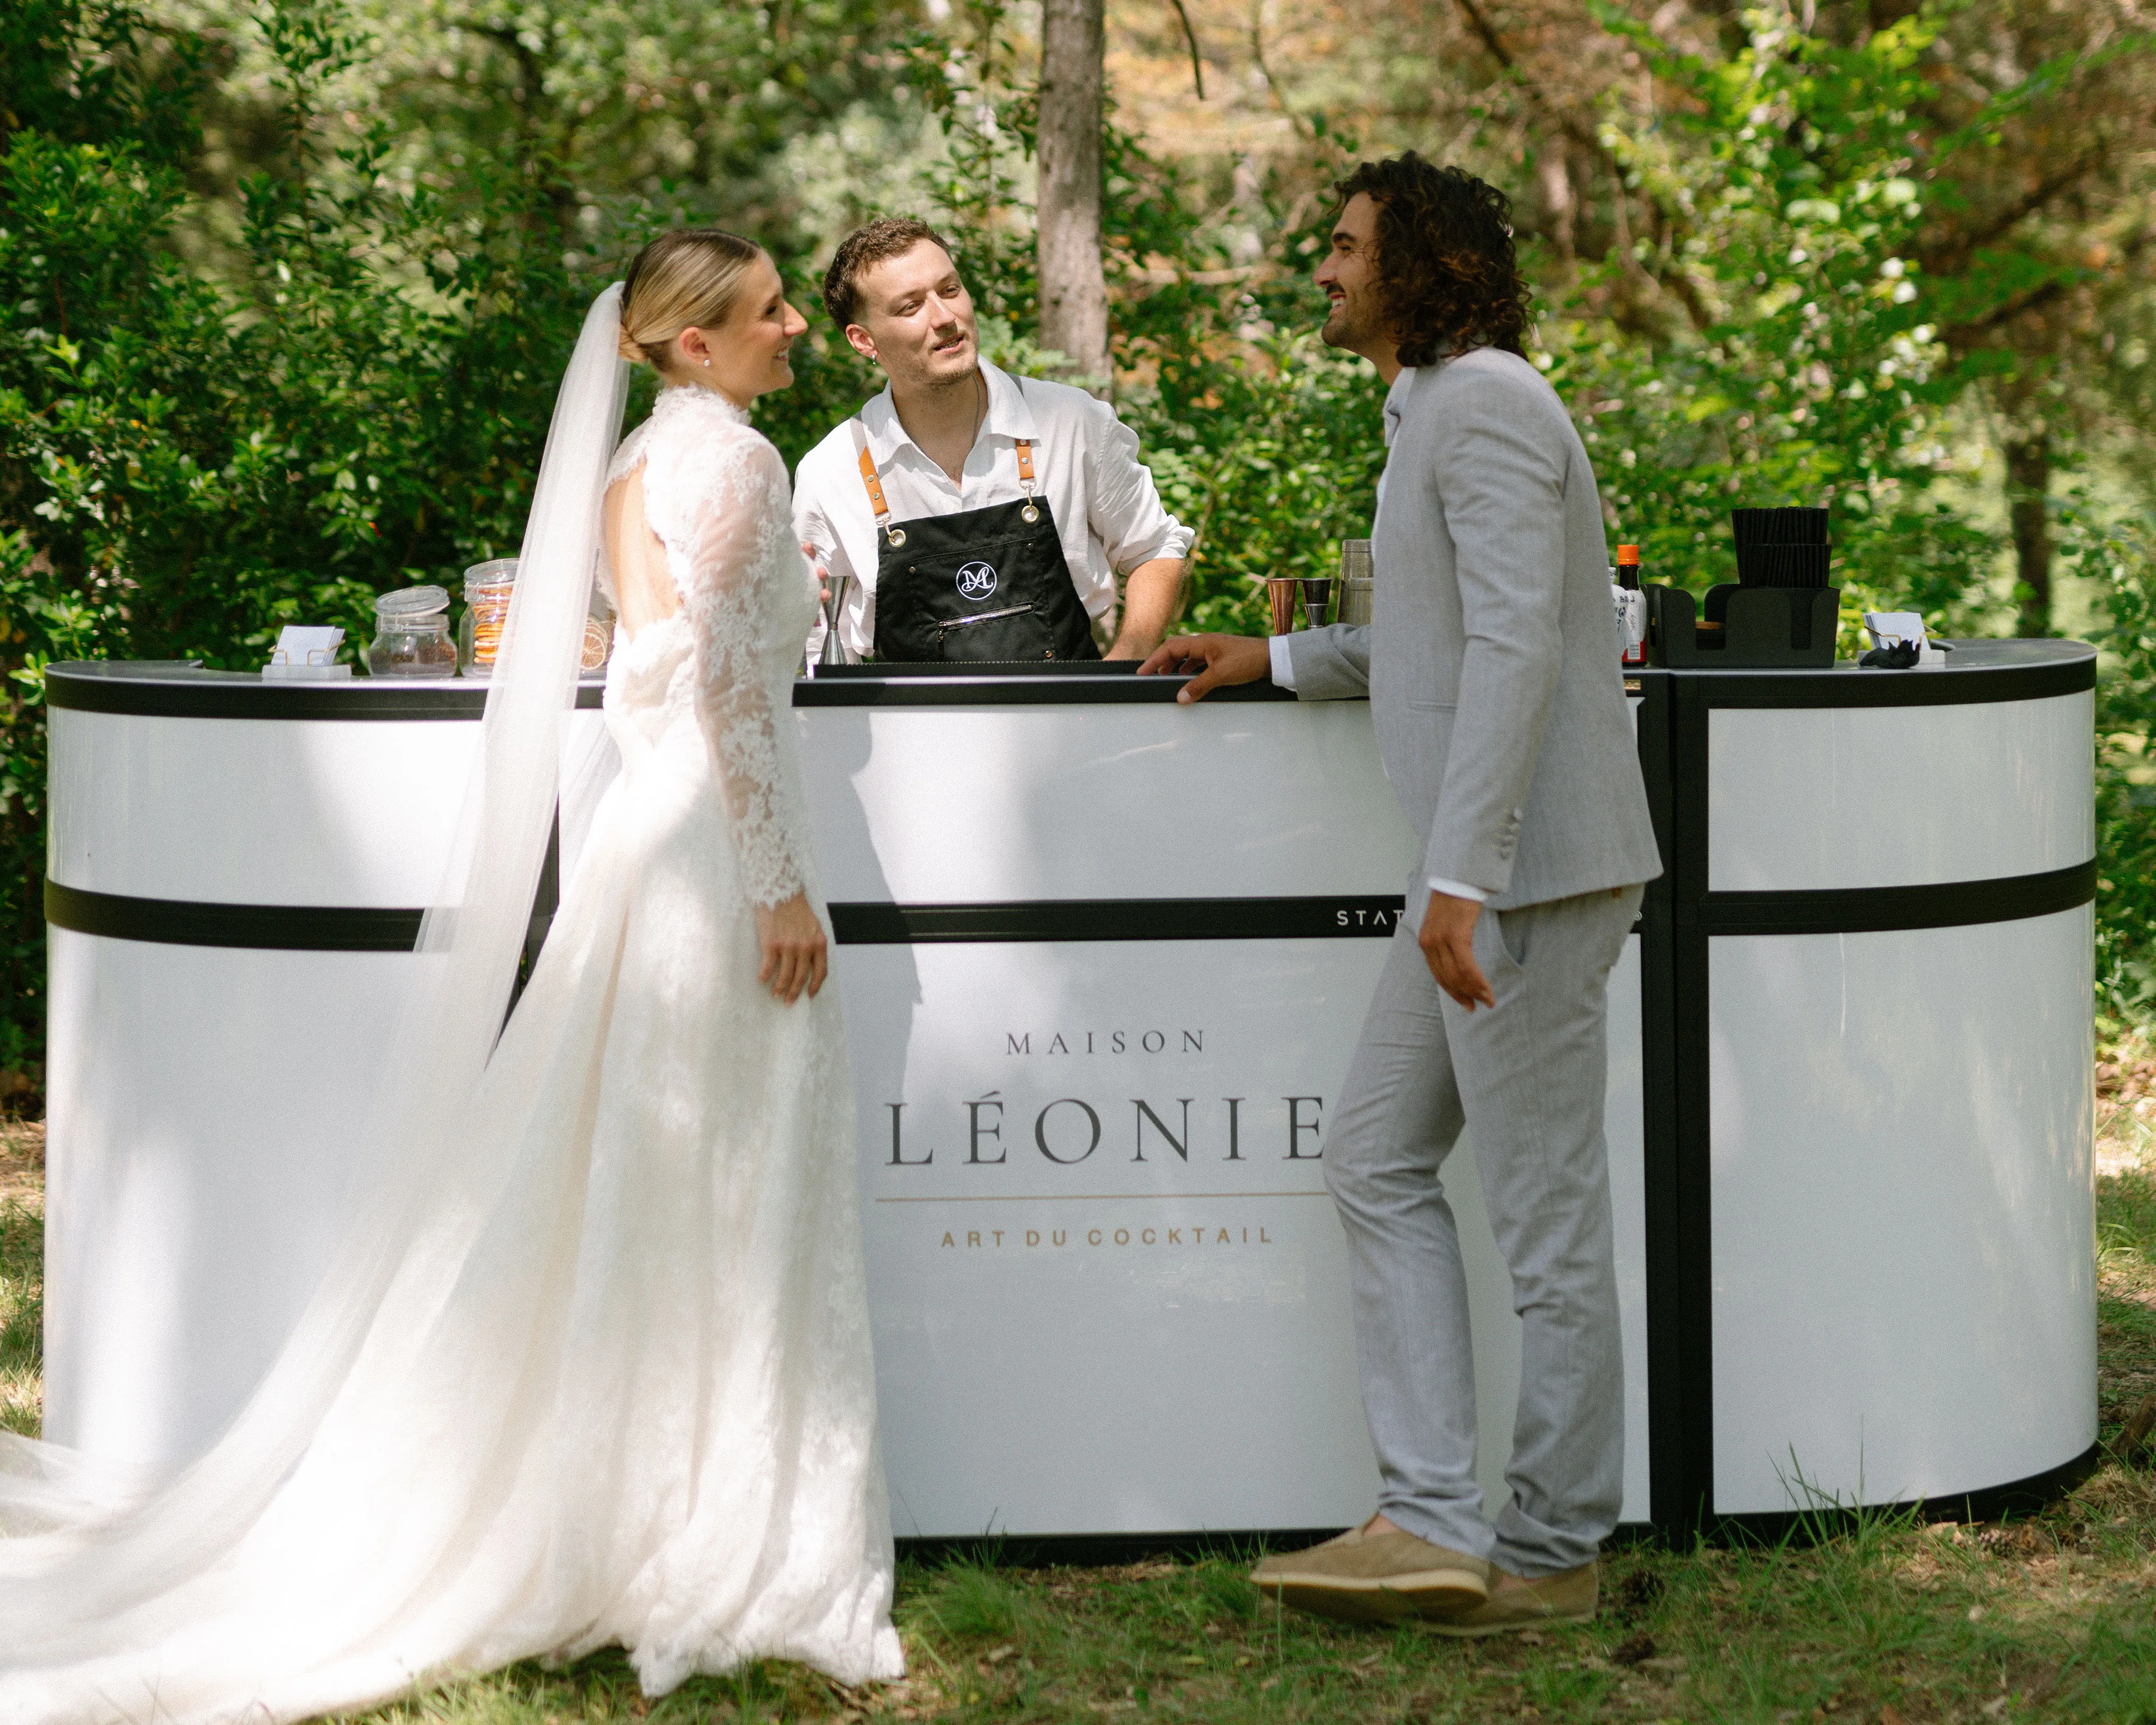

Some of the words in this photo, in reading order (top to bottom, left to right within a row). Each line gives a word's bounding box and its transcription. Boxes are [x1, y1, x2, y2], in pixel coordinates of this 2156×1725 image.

[1006, 1028, 1204, 1055] MAISON
[884, 1090, 1325, 1166] LÉONIE
[941, 1230, 1004, 1248] ART
[1025, 1229, 1067, 1246] DU
[1088, 1227, 1273, 1246] COCKTAIL
